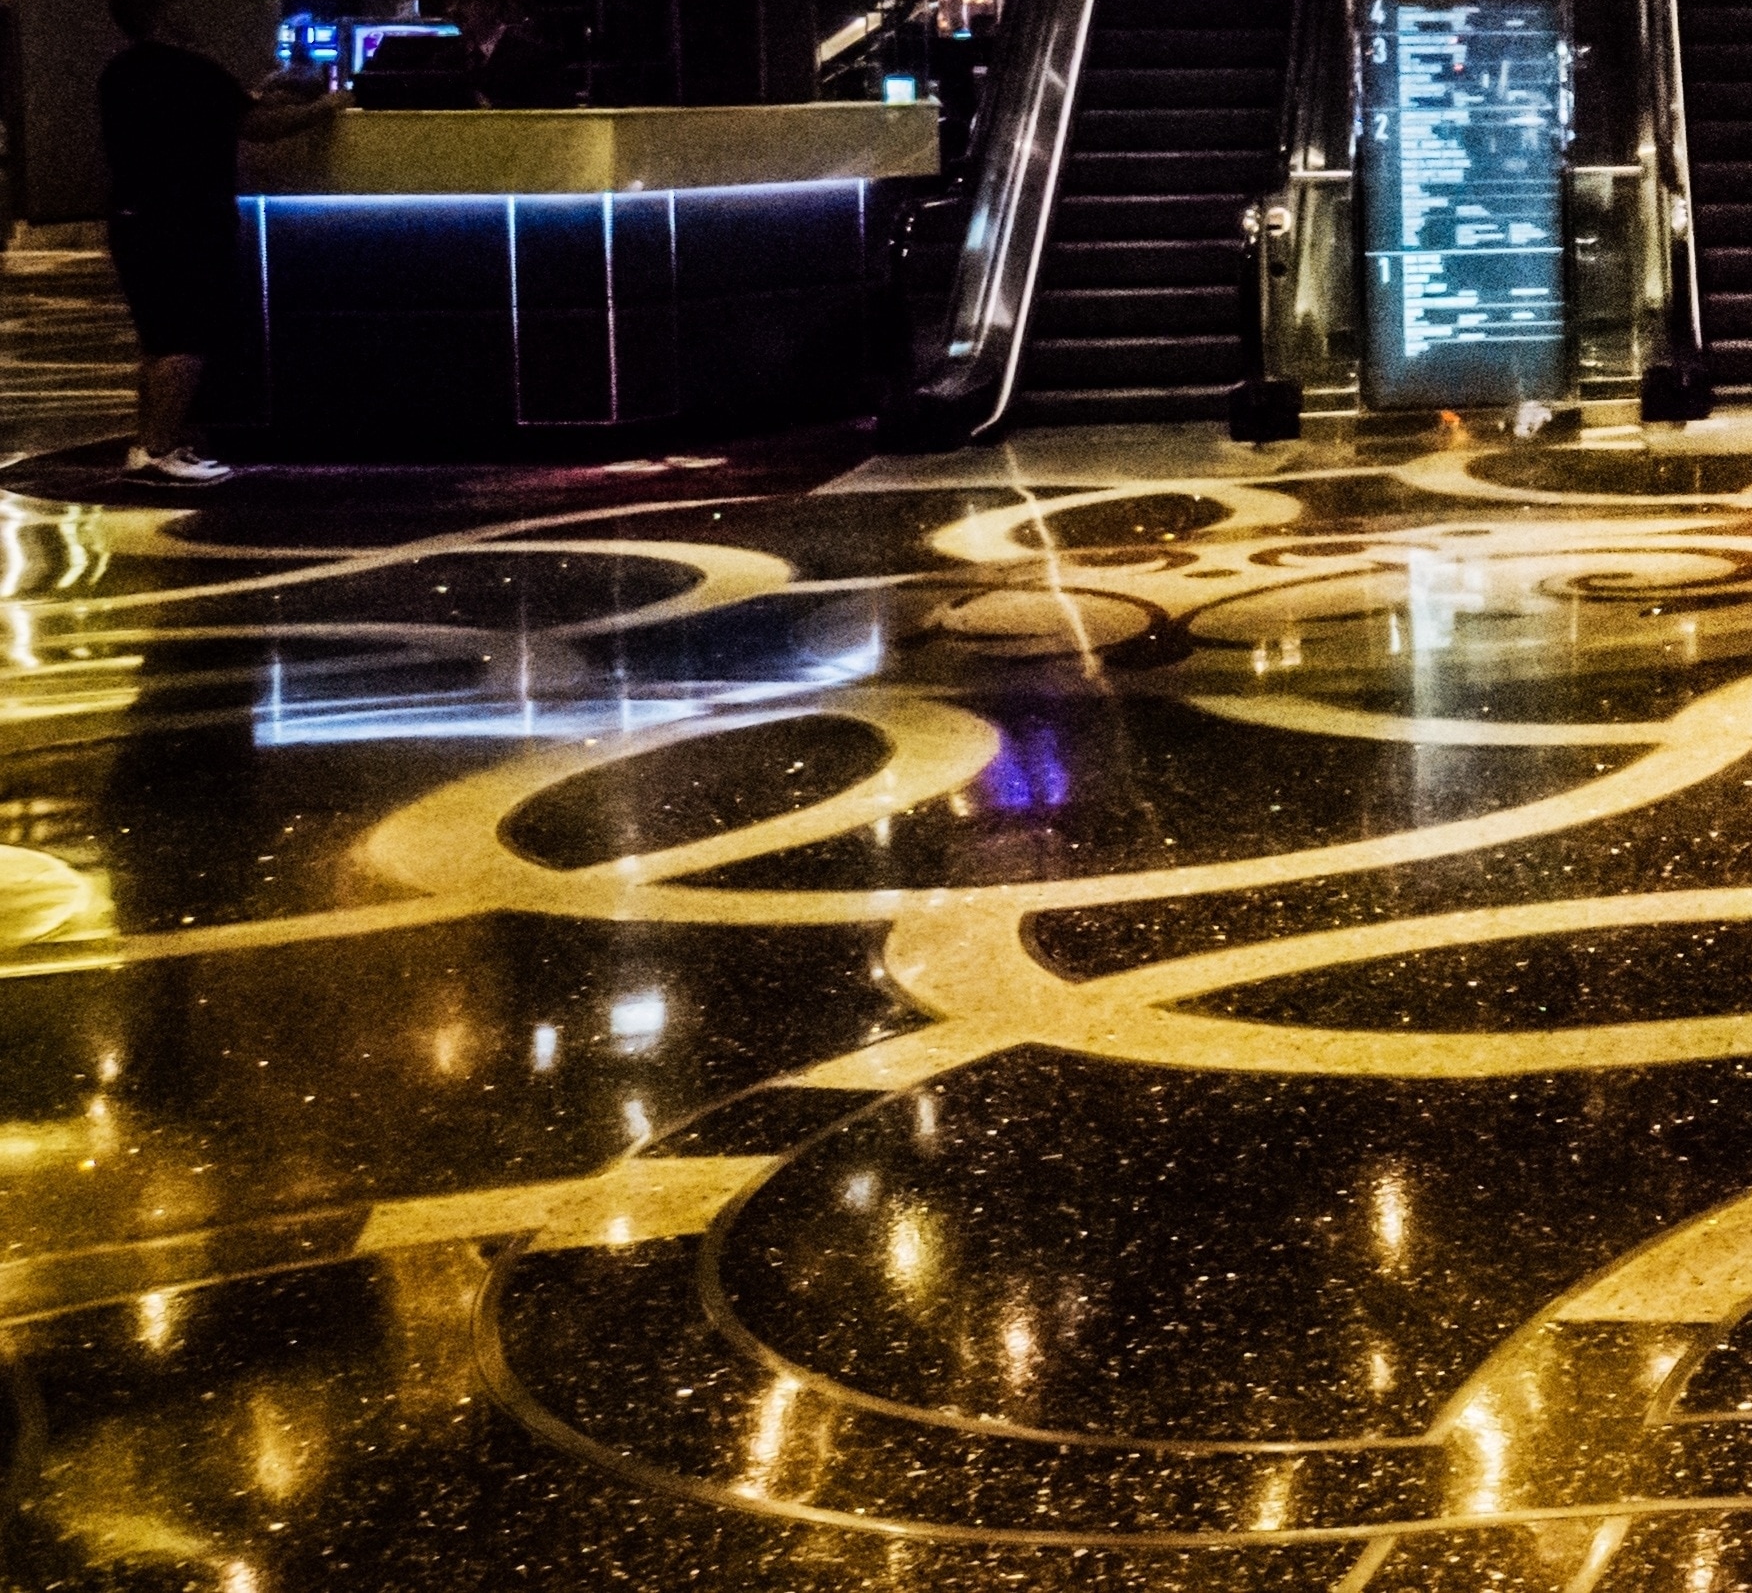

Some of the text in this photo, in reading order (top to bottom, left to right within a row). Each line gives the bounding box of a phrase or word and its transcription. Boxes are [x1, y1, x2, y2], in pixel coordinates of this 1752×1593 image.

[1372, 36, 1387, 63] 3
[1374, 113, 1389, 140] 2
[1378, 257, 1390, 283] 1
